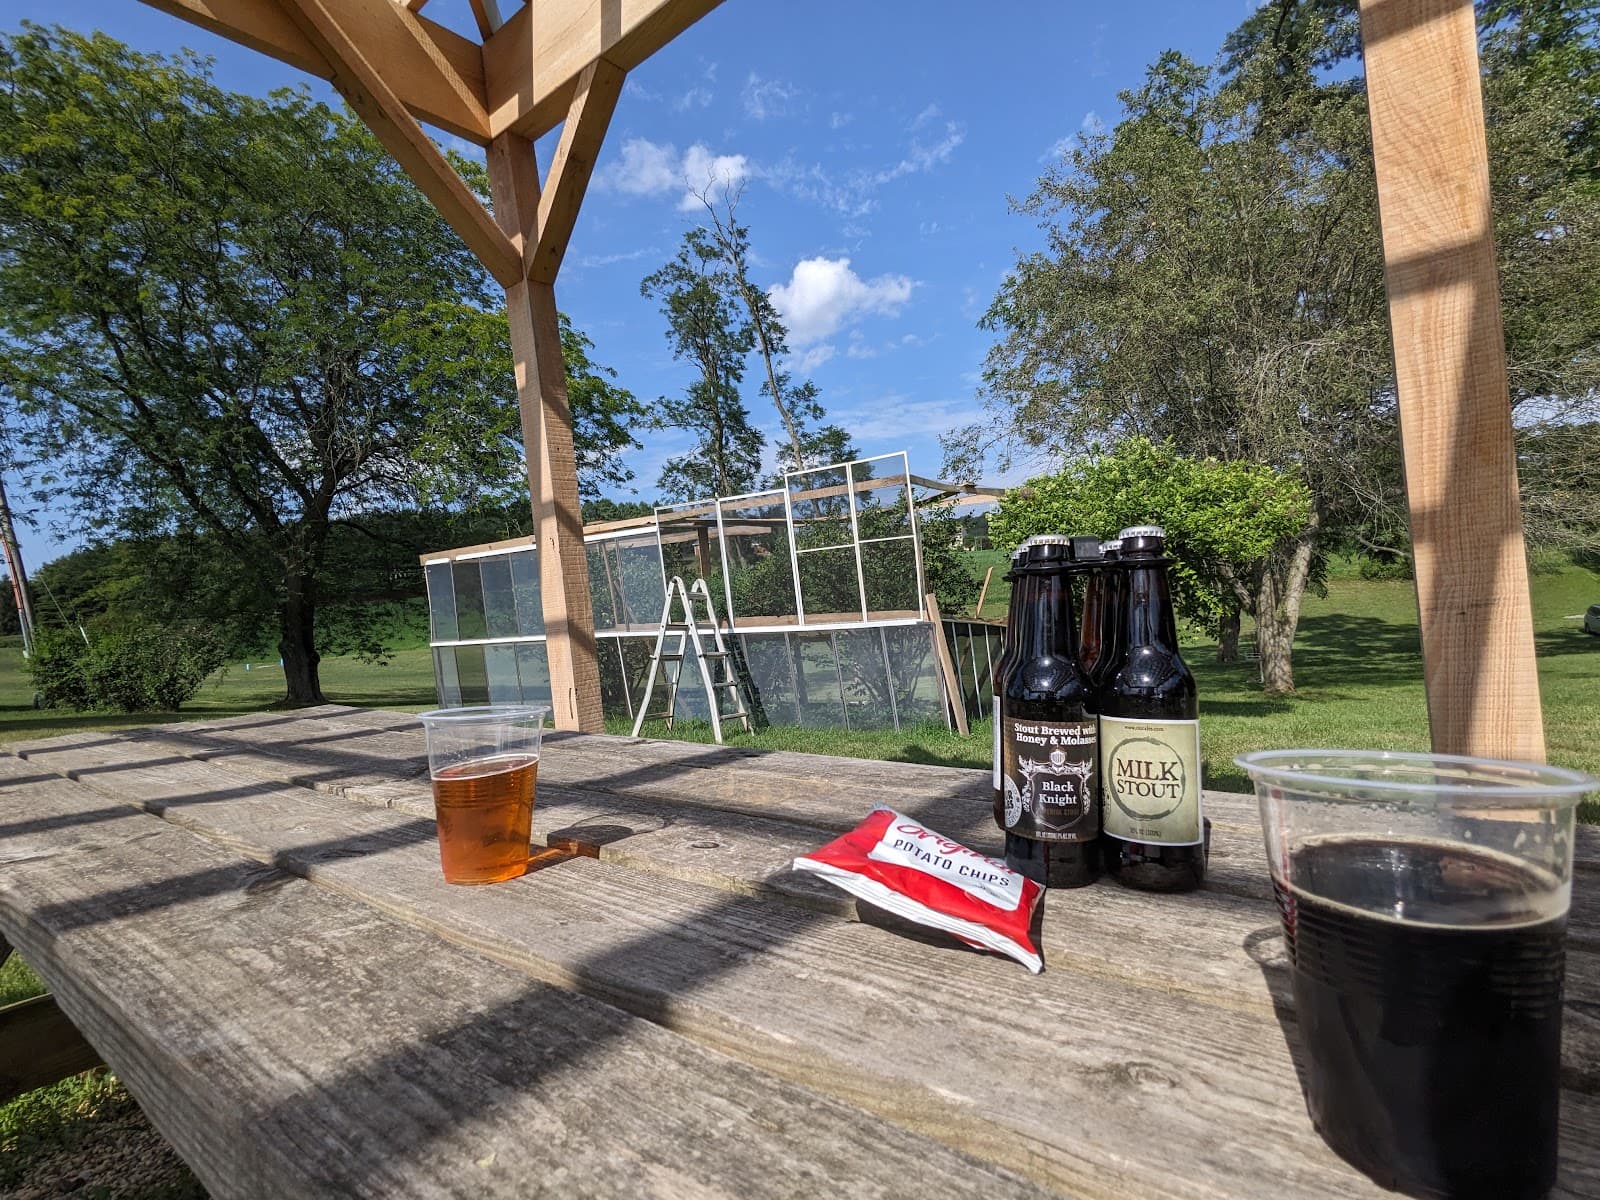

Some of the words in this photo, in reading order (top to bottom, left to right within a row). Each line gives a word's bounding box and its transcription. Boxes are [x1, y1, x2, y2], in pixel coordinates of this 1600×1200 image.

[1014, 723, 1040, 735] Stout
[1041, 725, 1081, 736] Brewed
[1016, 732, 1048, 747] Honey
[1050, 736, 1059, 745] &
[1116, 758, 1179, 781] MILK
[1042, 781, 1074, 792] Black
[1117, 779, 1180, 799] STOUT
[1038, 793, 1078, 807] Knight
[893, 839, 953, 870] POTATO
[958, 865, 1010, 887] CHIPS
